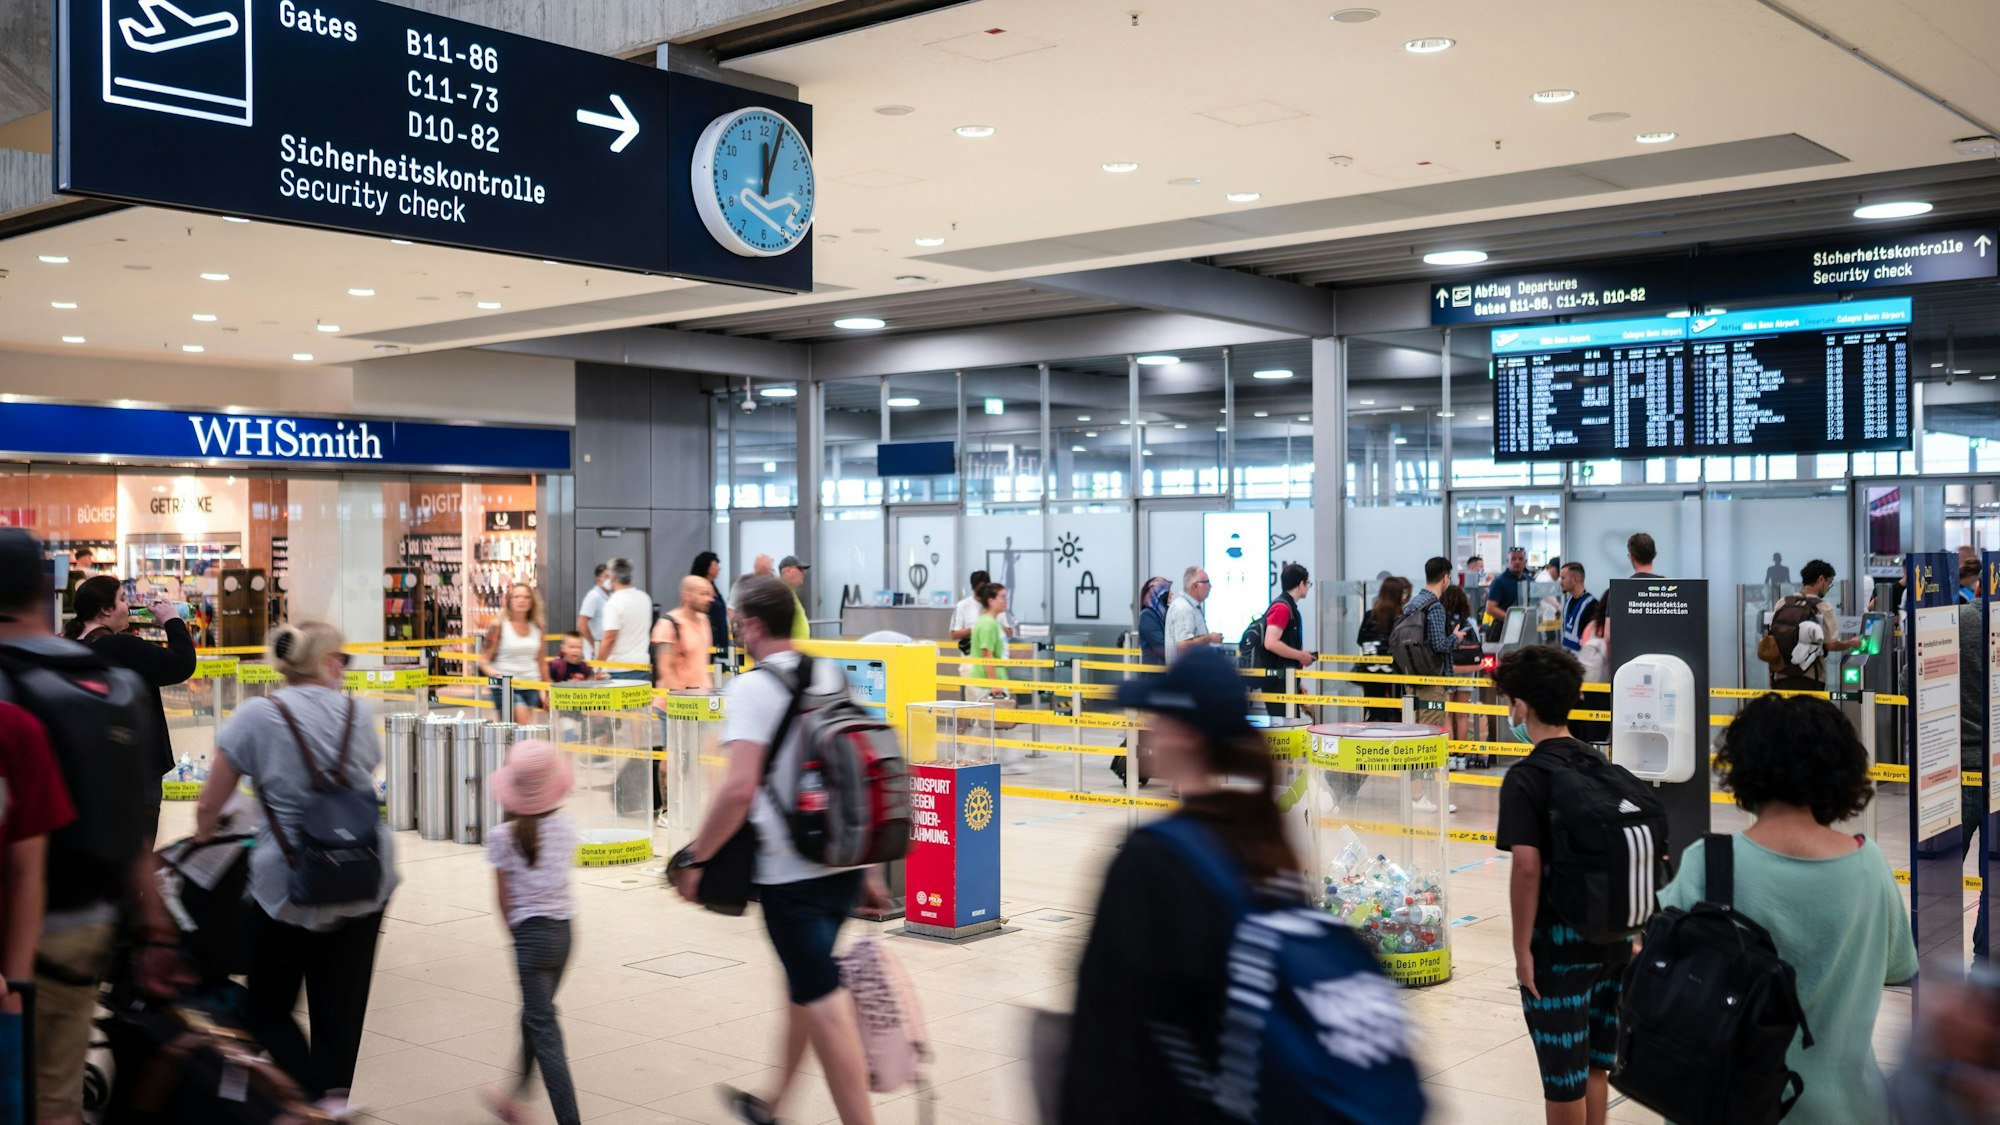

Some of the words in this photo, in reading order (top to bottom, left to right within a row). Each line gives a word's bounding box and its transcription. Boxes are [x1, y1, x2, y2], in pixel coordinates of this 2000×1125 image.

[280, 0, 358, 42] Gates
[407, 28, 498, 74] B11-86
[408, 70, 499, 113] C11-73
[408, 110, 500, 153] D10-82
[741, 129, 752, 140] 11
[760, 125, 769, 137] 12
[727, 145, 737, 157] 10
[280, 133, 546, 205] Sicherheitskontrolle
[793, 161, 798, 171] 2
[723, 169, 728, 180] 9
[280, 167, 389, 216] Security
[398, 188, 466, 223] check
[798, 184, 804, 196] 3
[728, 196, 734, 207] 8
[741, 219, 747, 230] 7
[761, 229, 767, 240] 6
[780, 226, 786, 237] 5
[1813, 239, 1964, 267] Sicherheitskontrolle
[1813, 267, 1869, 285] Security
[1874, 263, 1912, 279] check
[1475, 283, 1511, 299] Abflug
[1518, 278, 1578, 296] Departures
[1475, 300, 1506, 316] Gates
[1557, 291, 1599, 309] C11-73,
[1603, 287, 1646, 305] D10-82
[1881, 311, 1906, 321] Airport
[189, 415, 383, 459] WHSmith
[150, 496, 212, 515] GETRKE
[421, 493, 463, 514] DIGIT
[590, 691, 610, 699] Pfand
[1267, 736, 1290, 746] Pfand
[1356, 745, 1390, 757] Spende
[1393, 745, 1414, 755] Dein
[1417, 744, 1437, 755] Pfand
[1882, 771, 1907, 780] Airport
[909, 776, 951, 795] ENDSPURT
[910, 792, 935, 810] GEGEN
[910, 809, 941, 827] KINDER-
[909, 824, 951, 846] LÄHMUNG.
[582, 847, 607, 855] Donate
[608, 847, 623, 856] your
[625, 843, 646, 854] deposit
[1396, 958, 1417, 969] Dein
[1420, 956, 1440, 968] Pfand
